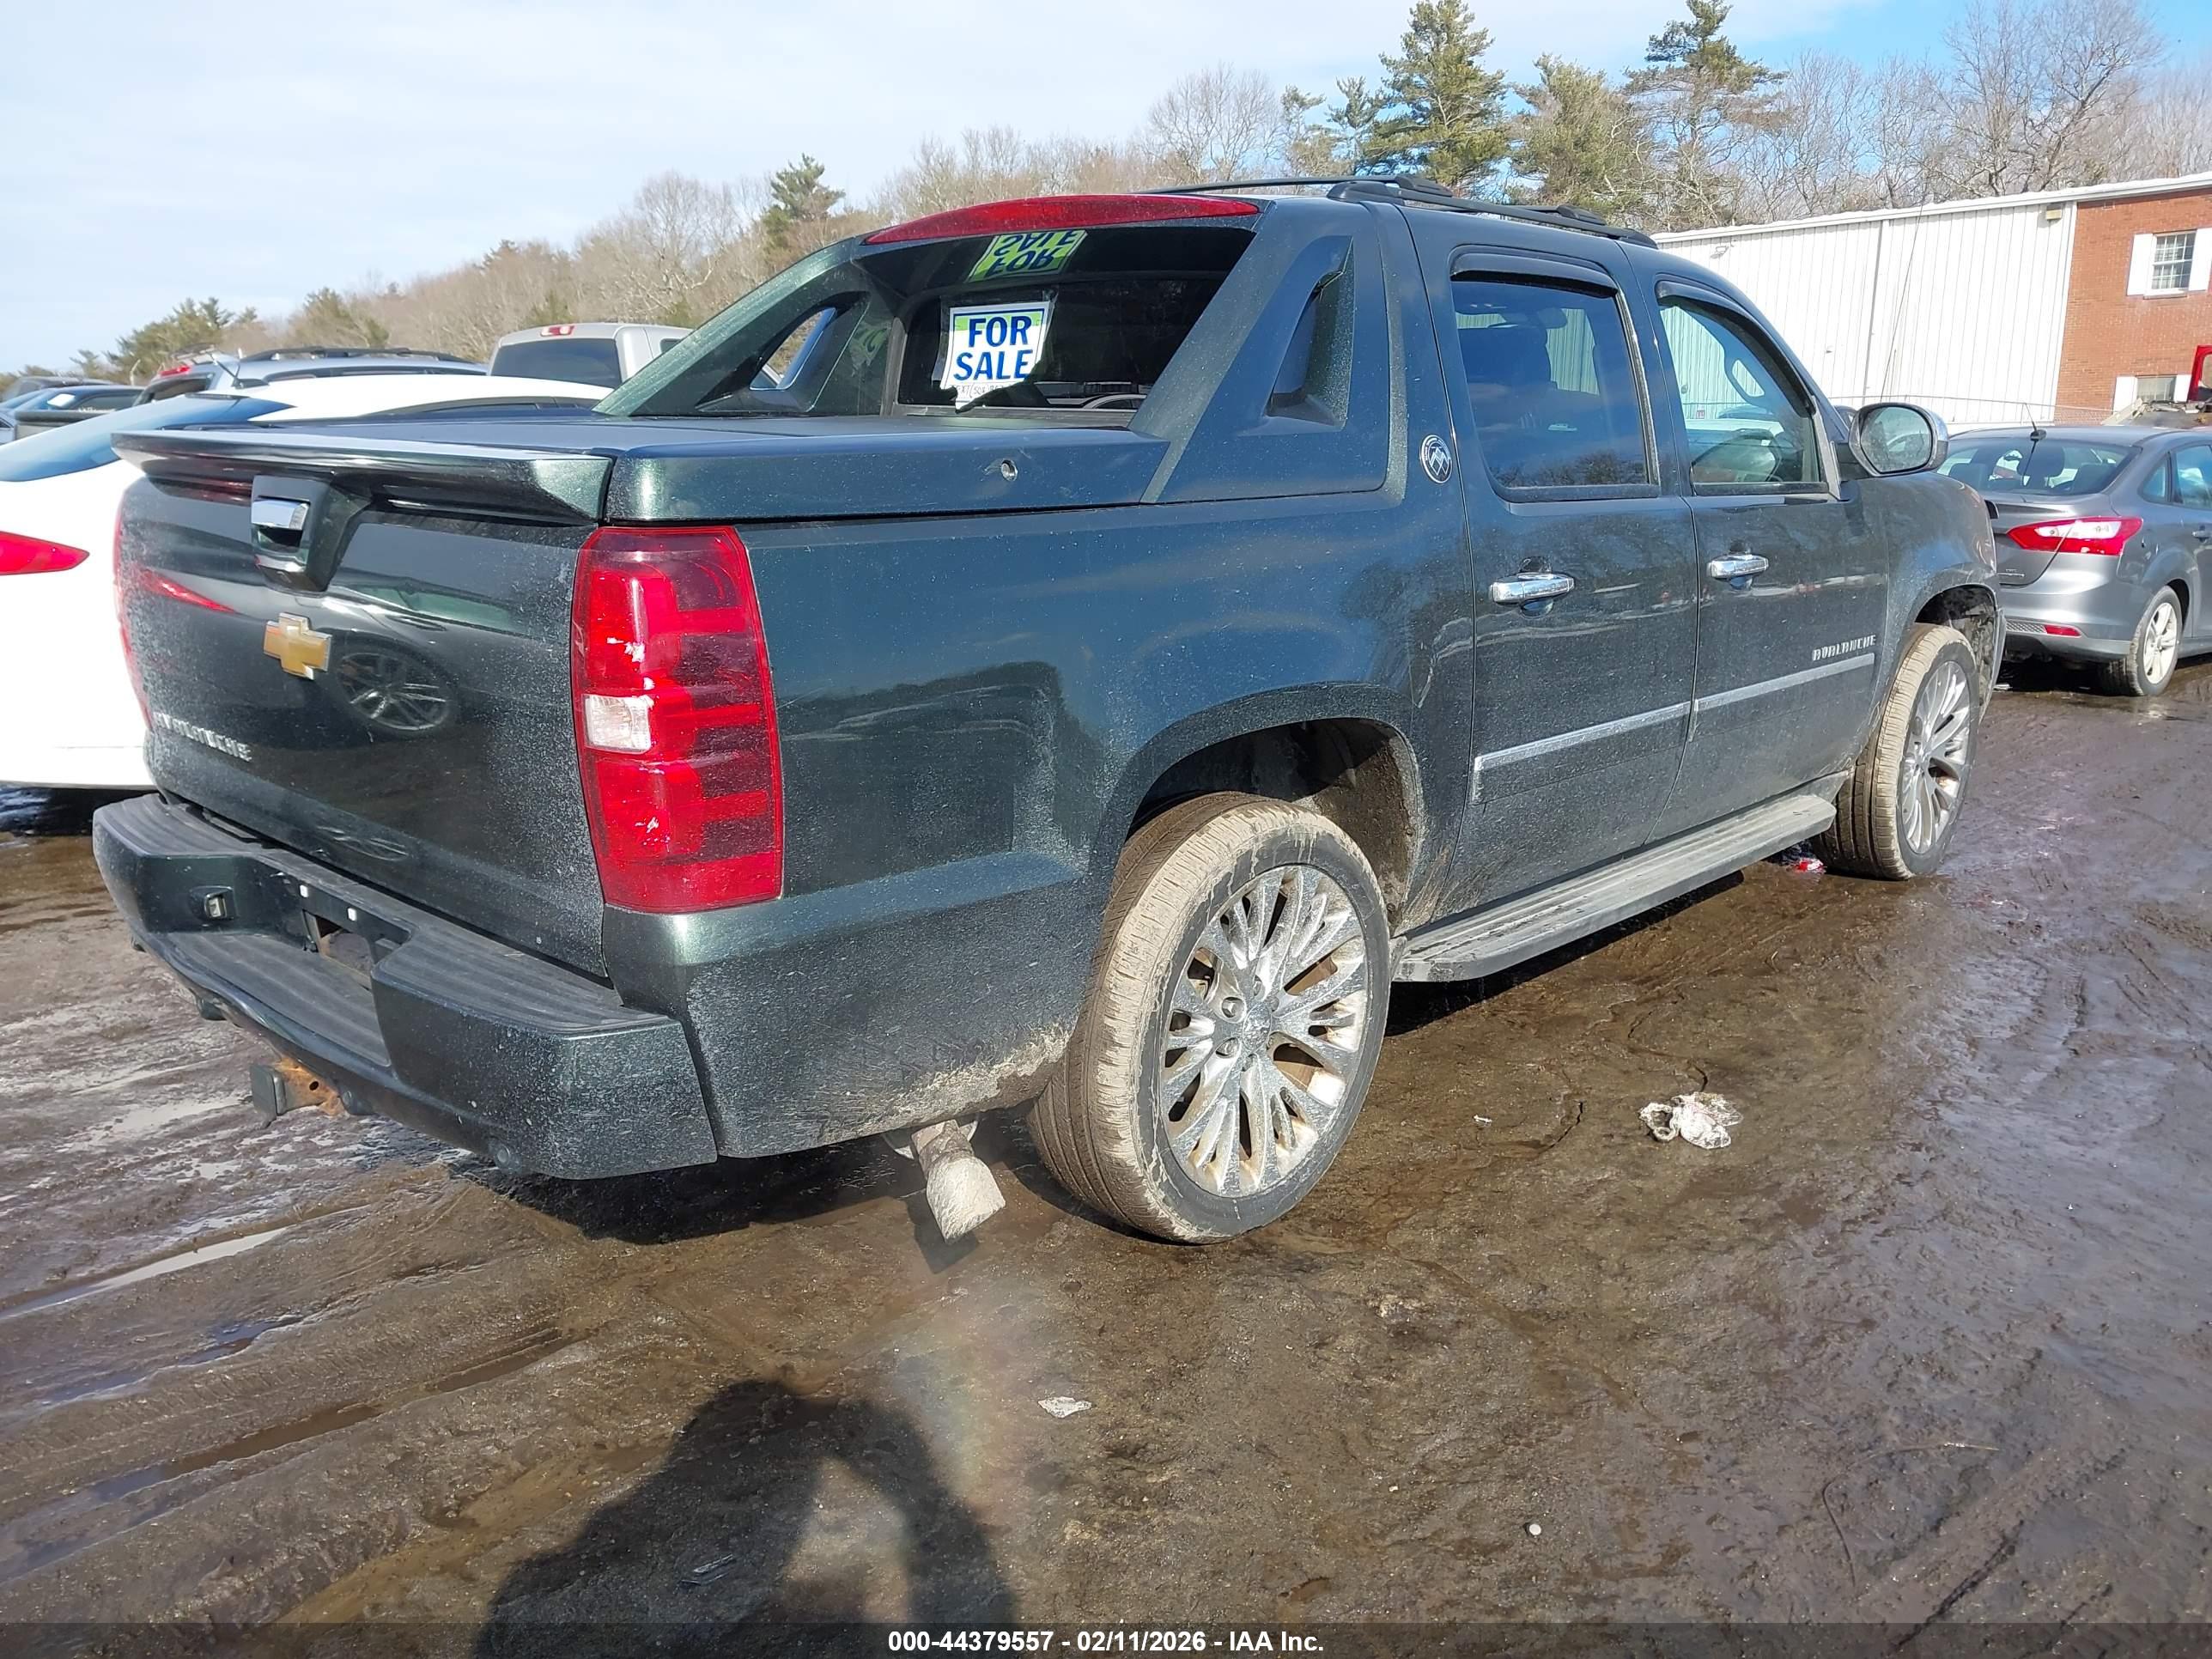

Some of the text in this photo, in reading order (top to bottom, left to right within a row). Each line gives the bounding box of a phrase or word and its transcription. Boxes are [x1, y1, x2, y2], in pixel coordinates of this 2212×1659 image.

[968, 315, 1032, 348] FOR
[953, 349, 1033, 380] SALE
[1812, 634, 1876, 661] AVALANCHE
